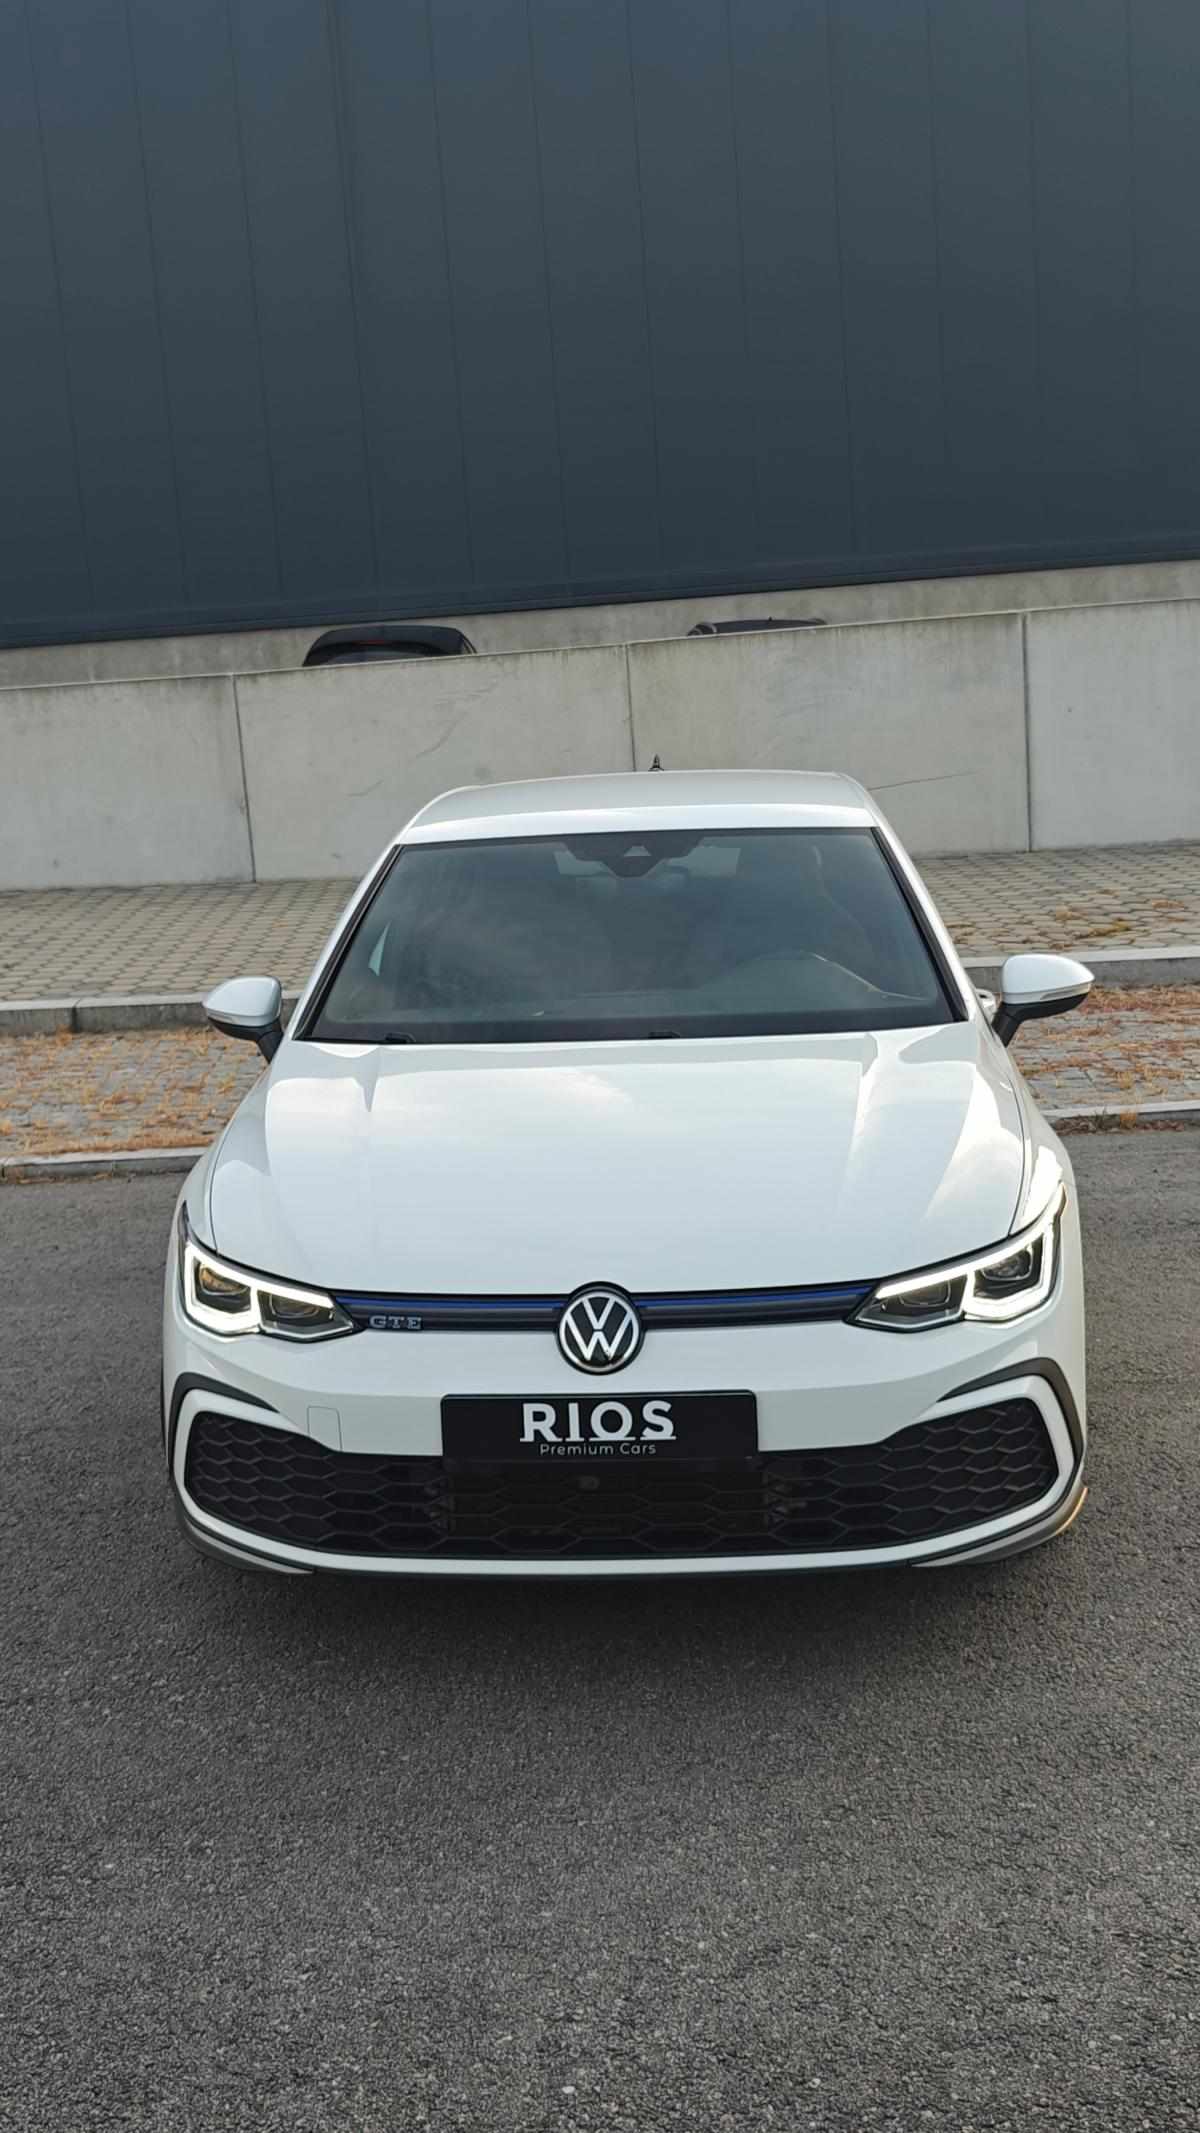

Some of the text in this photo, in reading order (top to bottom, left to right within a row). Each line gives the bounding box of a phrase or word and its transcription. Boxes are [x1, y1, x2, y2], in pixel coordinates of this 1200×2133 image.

[369, 1315, 422, 1330] GTE
[519, 1400, 676, 1442] RIOS
[540, 1442, 656, 1456] Premium Cars
